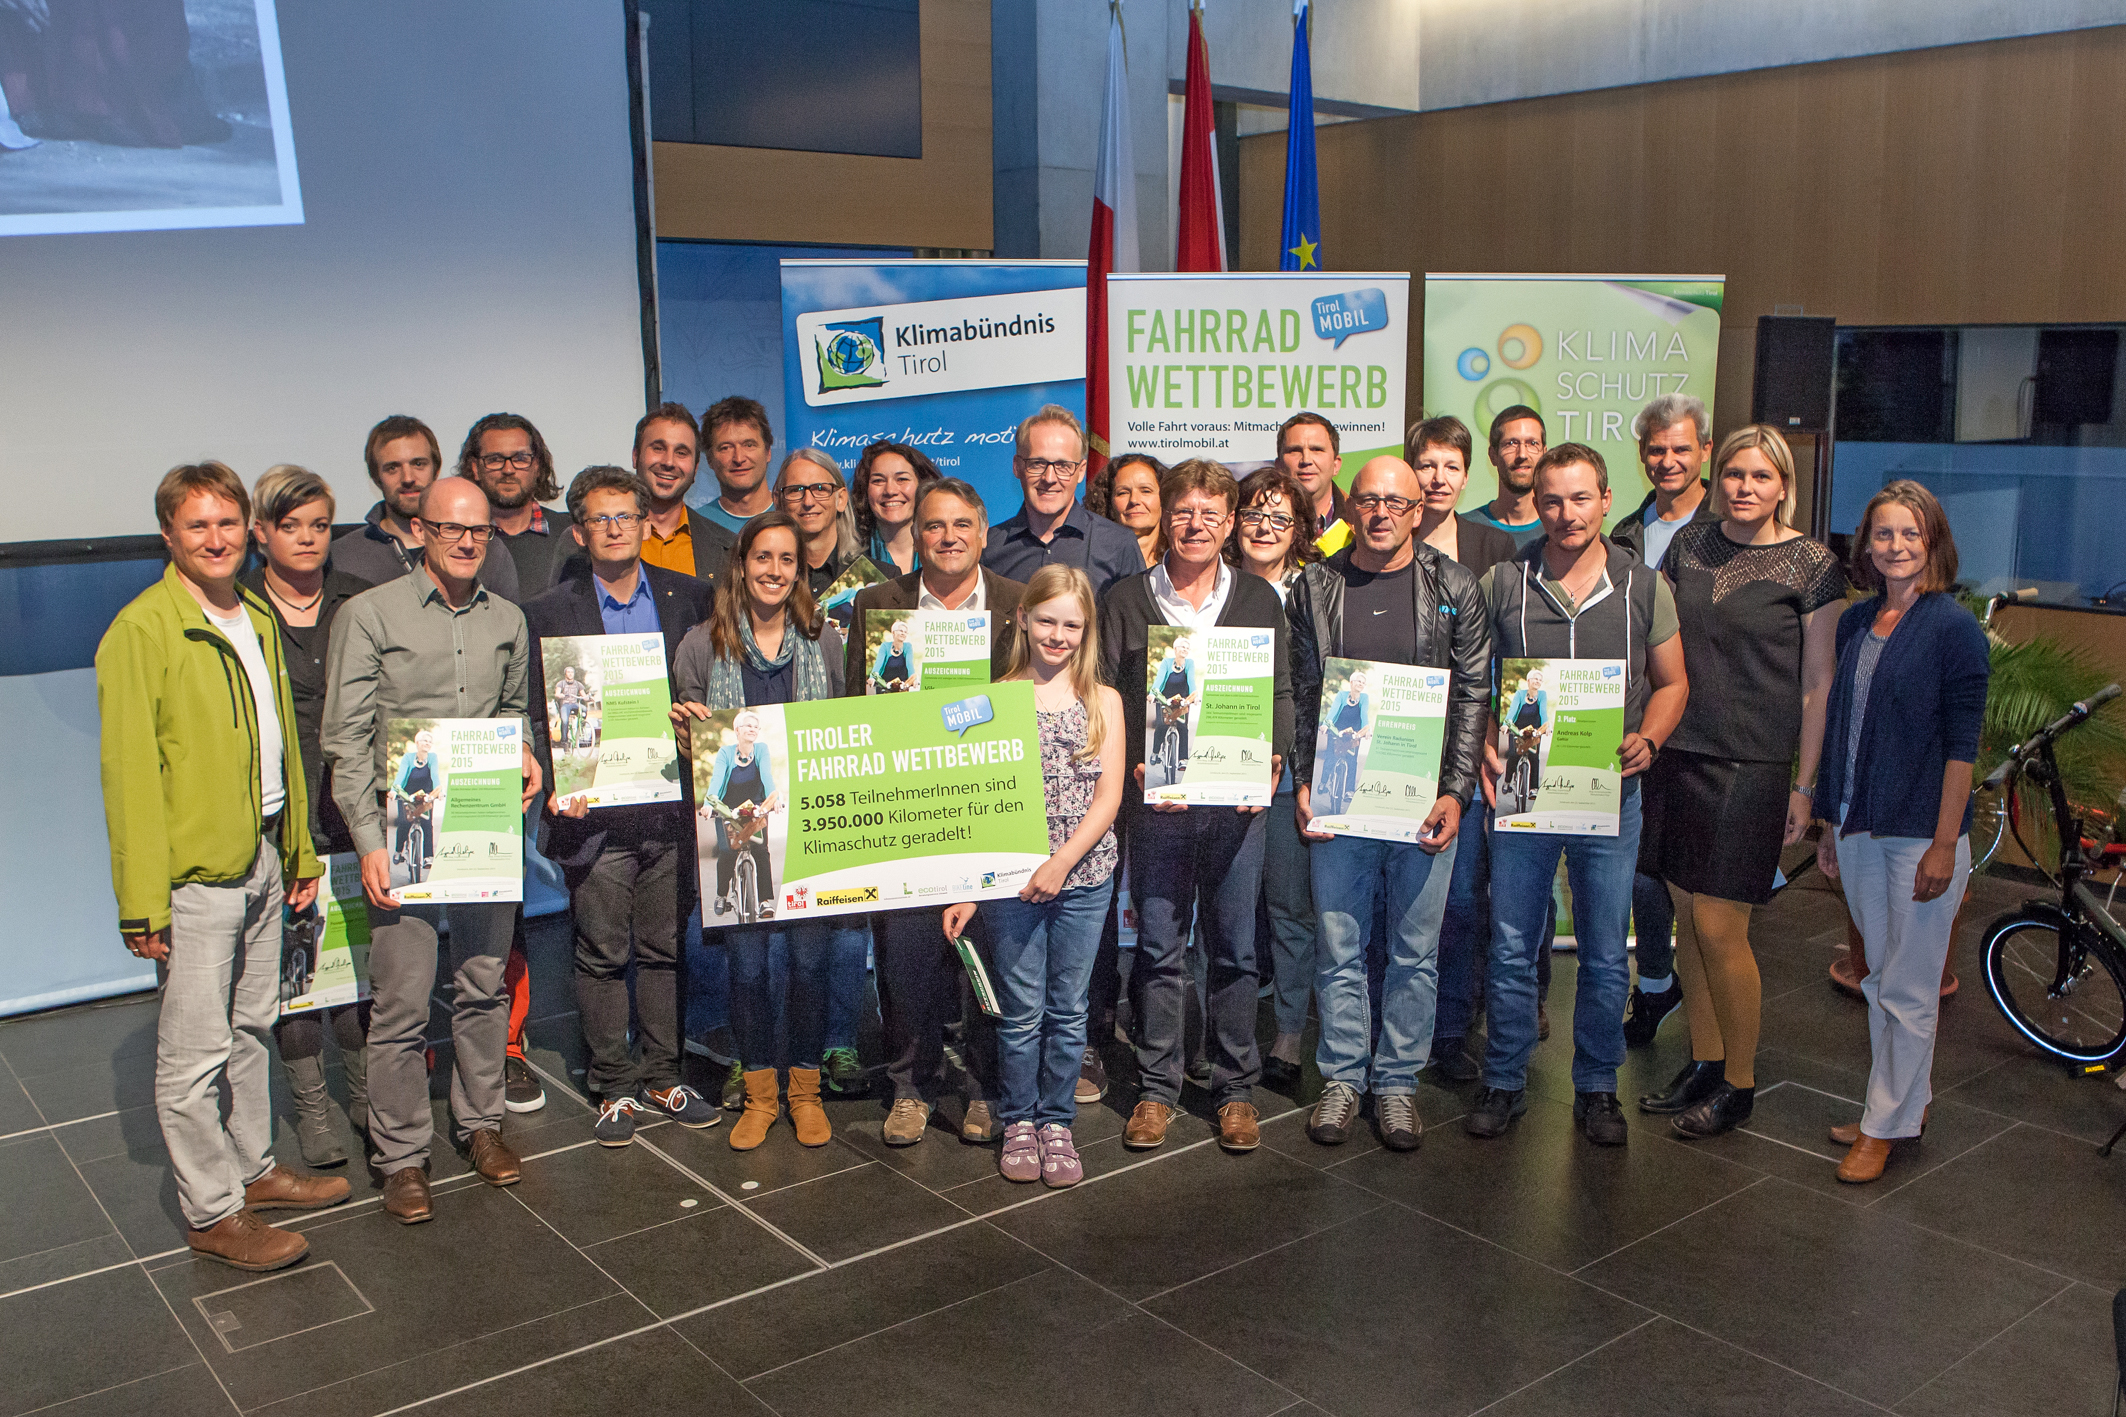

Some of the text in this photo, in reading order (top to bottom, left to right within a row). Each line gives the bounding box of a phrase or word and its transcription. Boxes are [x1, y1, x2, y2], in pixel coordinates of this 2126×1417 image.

[1316, 300, 1340, 315] Tirol
[1319, 309, 1369, 333] MOBIL
[896, 312, 1055, 347] Klimabündnis
[1127, 309, 1300, 353] FAHRRAD
[1558, 330, 1689, 362] KLIMA
[898, 350, 948, 376] Tirol
[1127, 365, 1387, 409] WETTBEWERB
[1557, 372, 1689, 401] SCHUTZ
[1128, 421, 1385, 432] Volle Fahrt voraus: Mitmach ewinnen!
[1557, 410, 1641, 441] TIR
[964, 425, 1017, 445] moti
[1128, 437, 1229, 449] www.tirolmobil.at
[925, 621, 965, 632] FAHRRAD
[925, 634, 985, 645] WETTBEWERB
[1207, 638, 1249, 650] FAHRRAD
[601, 644, 641, 655] FAHRRAD
[925, 647, 945, 658] 2015
[602, 656, 662, 668] WETTBEWERB
[1207, 651, 1269, 663] WETTBEWERB
[603, 670, 624, 681] 2015
[924, 667, 970, 675] AUSZEICHNUNG
[1207, 664, 1228, 675] 2015
[1560, 670, 1600, 681] FAHRRAD
[1383, 674, 1424, 689] FAHRRAD
[605, 688, 650, 697] AUSZEICHNUNG
[1206, 684, 1253, 693] AUSZEICHNUNG
[1559, 683, 1620, 694] WETTBEWERB
[1382, 687, 1443, 704] WETTBEWERB
[1558, 695, 1579, 706] 2015
[944, 706, 960, 716] Tirol
[1380, 700, 1401, 712] 2015
[947, 710, 982, 728] MOBIL
[1378, 720, 1416, 730] EHRENPREIS
[1563, 715, 1576, 723] Platz
[451, 730, 495, 741] FAHRRAD
[794, 724, 873, 753] TIROLER
[451, 744, 516, 755] WETTBEWERB
[451, 757, 473, 768] 2015
[797, 739, 1024, 782] FAHRRAD WETTBEWERB
[451, 778, 500, 786] AUSZEICHNUNG
[801, 775, 1017, 811] 5.058 TeilnehmerInnen sind
[802, 800, 1025, 833] 3.950.000 Kilometer für den
[804, 826, 973, 856] Klimaschutz geradelt!
[331, 862, 360, 874] FAHRR
[997, 868, 1032, 878] Klimabündnis
[332, 873, 360, 885] WETTB
[918, 885, 948, 894] ecotirol
[817, 895, 864, 906] Raiffeisen
